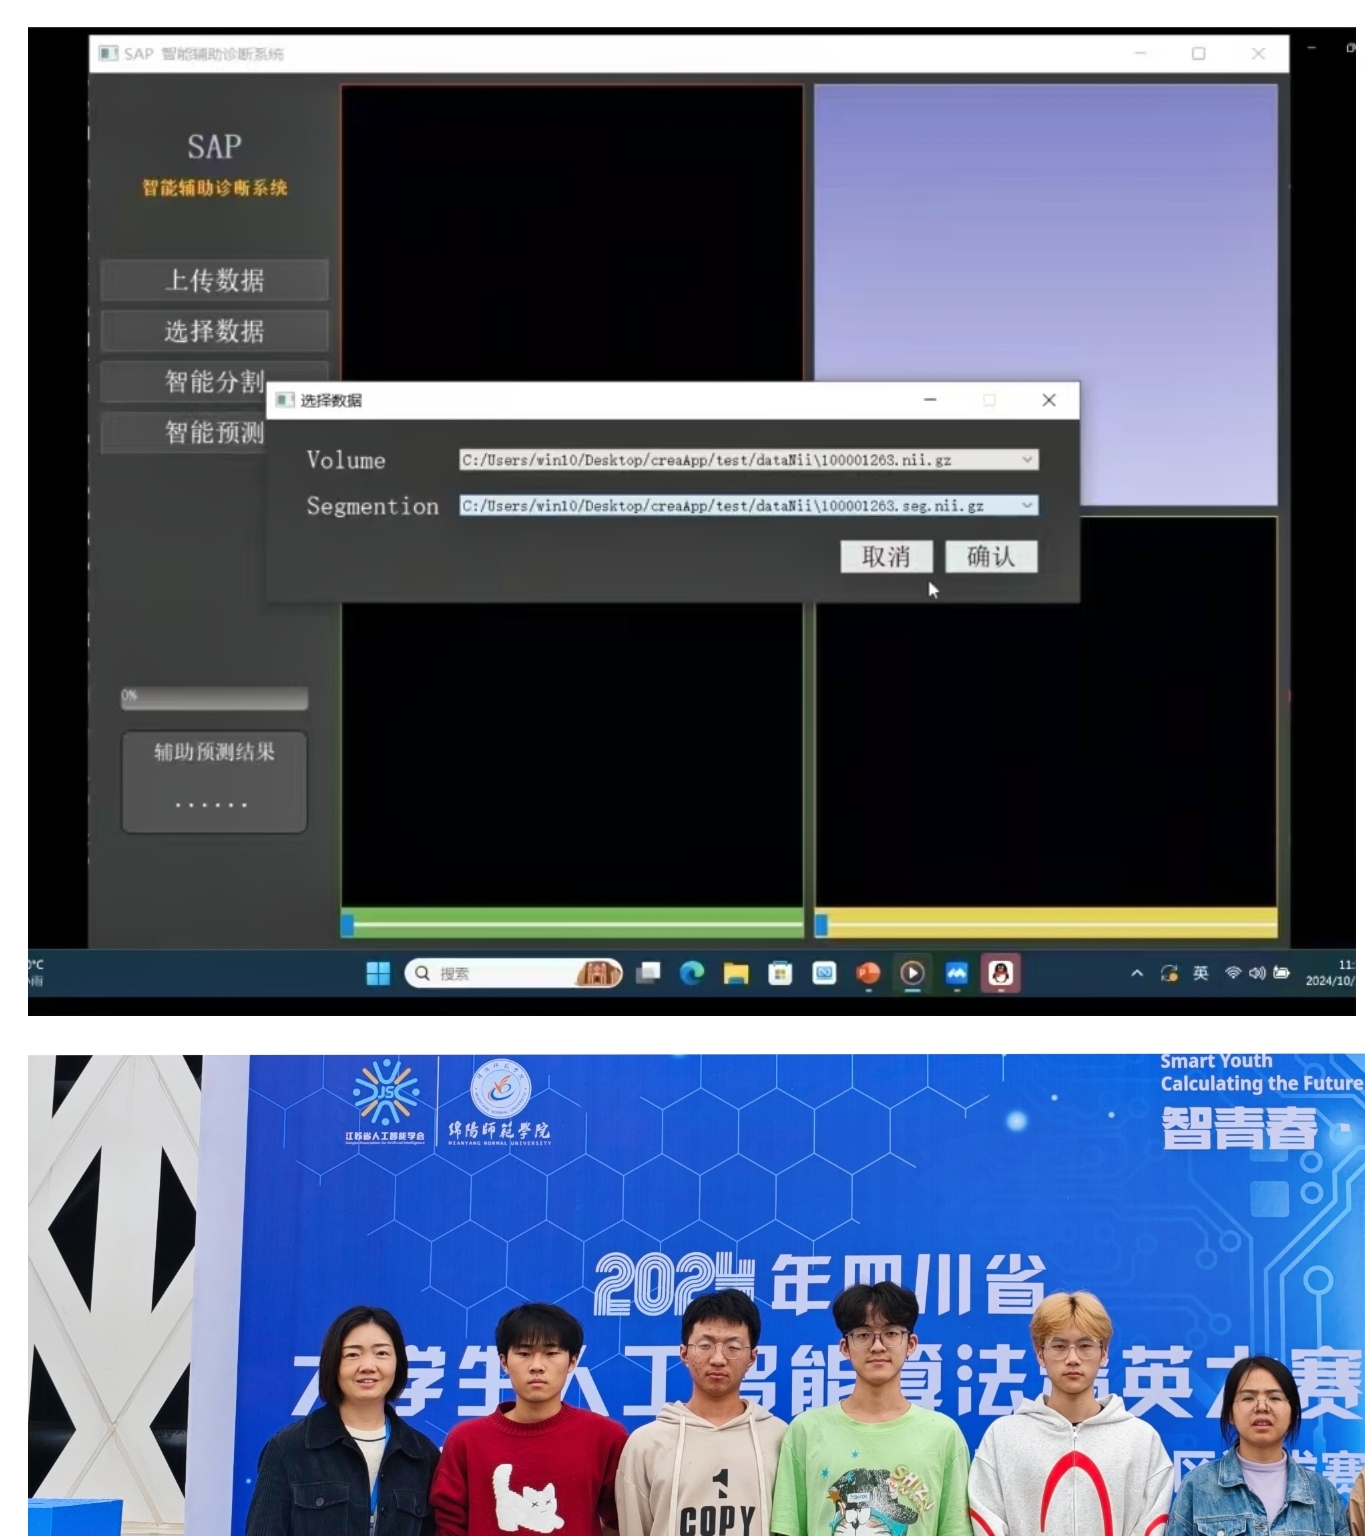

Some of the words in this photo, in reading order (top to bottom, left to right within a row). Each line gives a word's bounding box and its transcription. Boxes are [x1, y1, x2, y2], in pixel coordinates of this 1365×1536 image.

[124, 47, 153, 60] SAP
[162, 47, 284, 61] 智能辅助诊断系统
[188, 134, 241, 160] SAP
[142, 178, 288, 197] 智能辅助诊断系统
[165, 268, 264, 294] 上传数据
[164, 318, 264, 344] 选择数据
[165, 369, 264, 394] 智能分割
[301, 393, 362, 408] 选择数据
[165, 420, 264, 446] 智能预测
[307, 449, 386, 471] Volume
[307, 497, 439, 519] Segmention
[862, 545, 911, 569] 取消
[967, 545, 1016, 569] 确认
[154, 743, 275, 763] 辅助预测结果
[440, 966, 469, 982] 搜索
[1194, 965, 1208, 980] 英
[1160, 1054, 1227, 1070] Smart
[1233, 1054, 1273, 1070] Youth
[1161, 1074, 1262, 1094] Calculating
[1268, 1075, 1299, 1091] the
[1303, 1075, 1364, 1091] Future
[593, 1251, 1046, 1317] 2024年四川省
